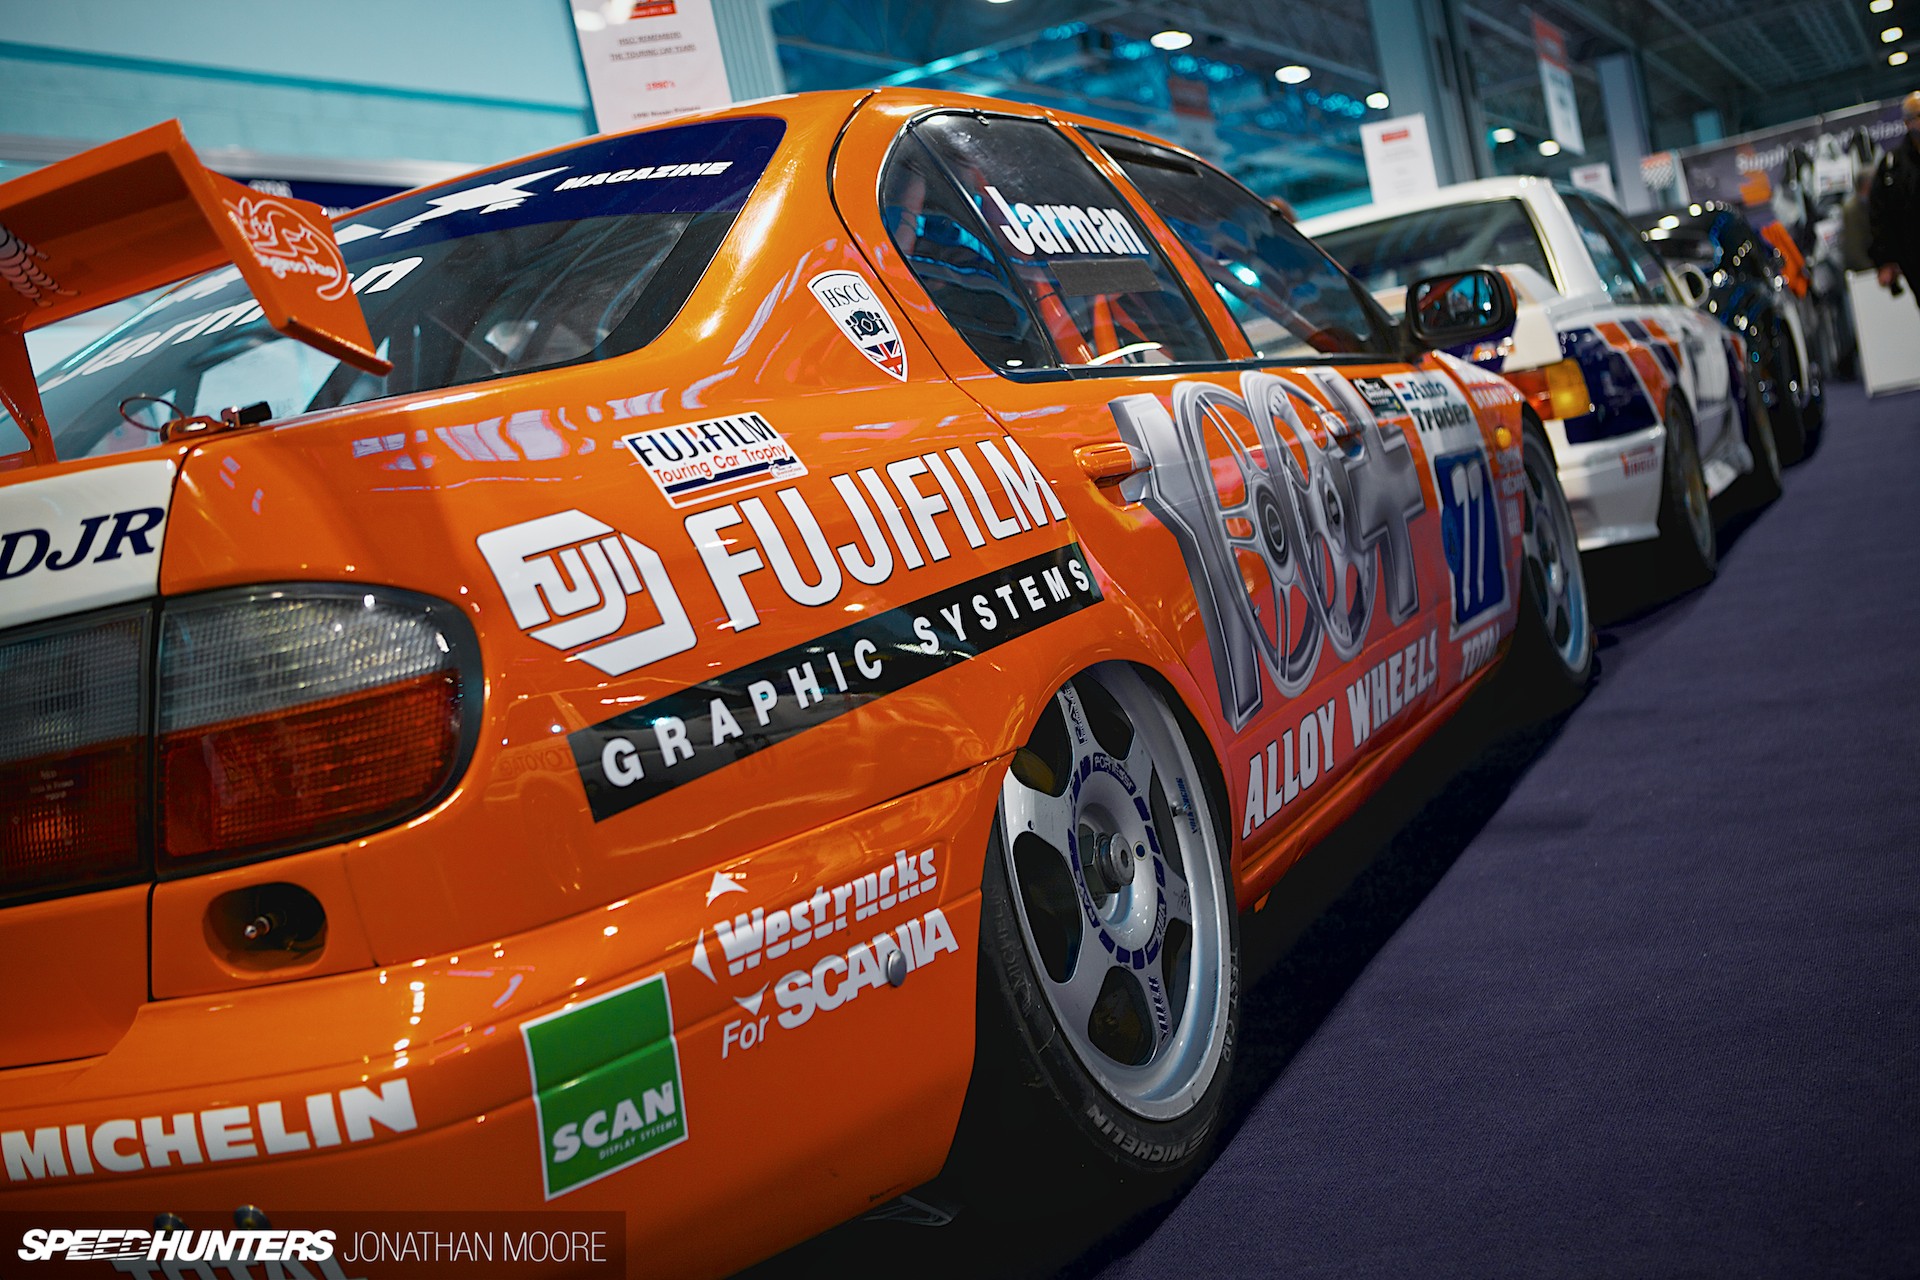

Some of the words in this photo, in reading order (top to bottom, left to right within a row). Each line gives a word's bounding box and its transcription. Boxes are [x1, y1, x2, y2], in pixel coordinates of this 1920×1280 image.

[554, 161, 733, 192] MAGAZINE
[984, 186, 1149, 256] Jarman
[38, 256, 424, 394] Jarmn
[820, 282, 871, 309] HSCC
[1407, 379, 1449, 400] Auto
[1411, 402, 1471, 433] Trader
[627, 414, 778, 467] FUJIFILM
[653, 461, 711, 485] Touring
[713, 453, 741, 469] Car
[742, 443, 789, 463] Trophy
[0, 506, 165, 579] DJR
[684, 435, 1068, 633] FUJIFILM
[1451, 459, 1485, 612] 77
[476, 509, 698, 677] FUJI
[601, 641, 884, 788] GRAPHIC
[912, 558, 1092, 655] SYSTEMS
[1242, 698, 1335, 840] ALLOY
[1347, 628, 1439, 749] WHEELS
[714, 848, 937, 976] Westrucks
[722, 1014, 769, 1060] For
[774, 908, 959, 1029] SCANIA
[0, 1077, 418, 1182] MICHELIN
[552, 1080, 676, 1163] SCAN
[599, 1137, 637, 1161] DISPLAY
[640, 1118, 679, 1142] SYSTEMS
[1087, 1104, 1187, 1162] MICHELIN
